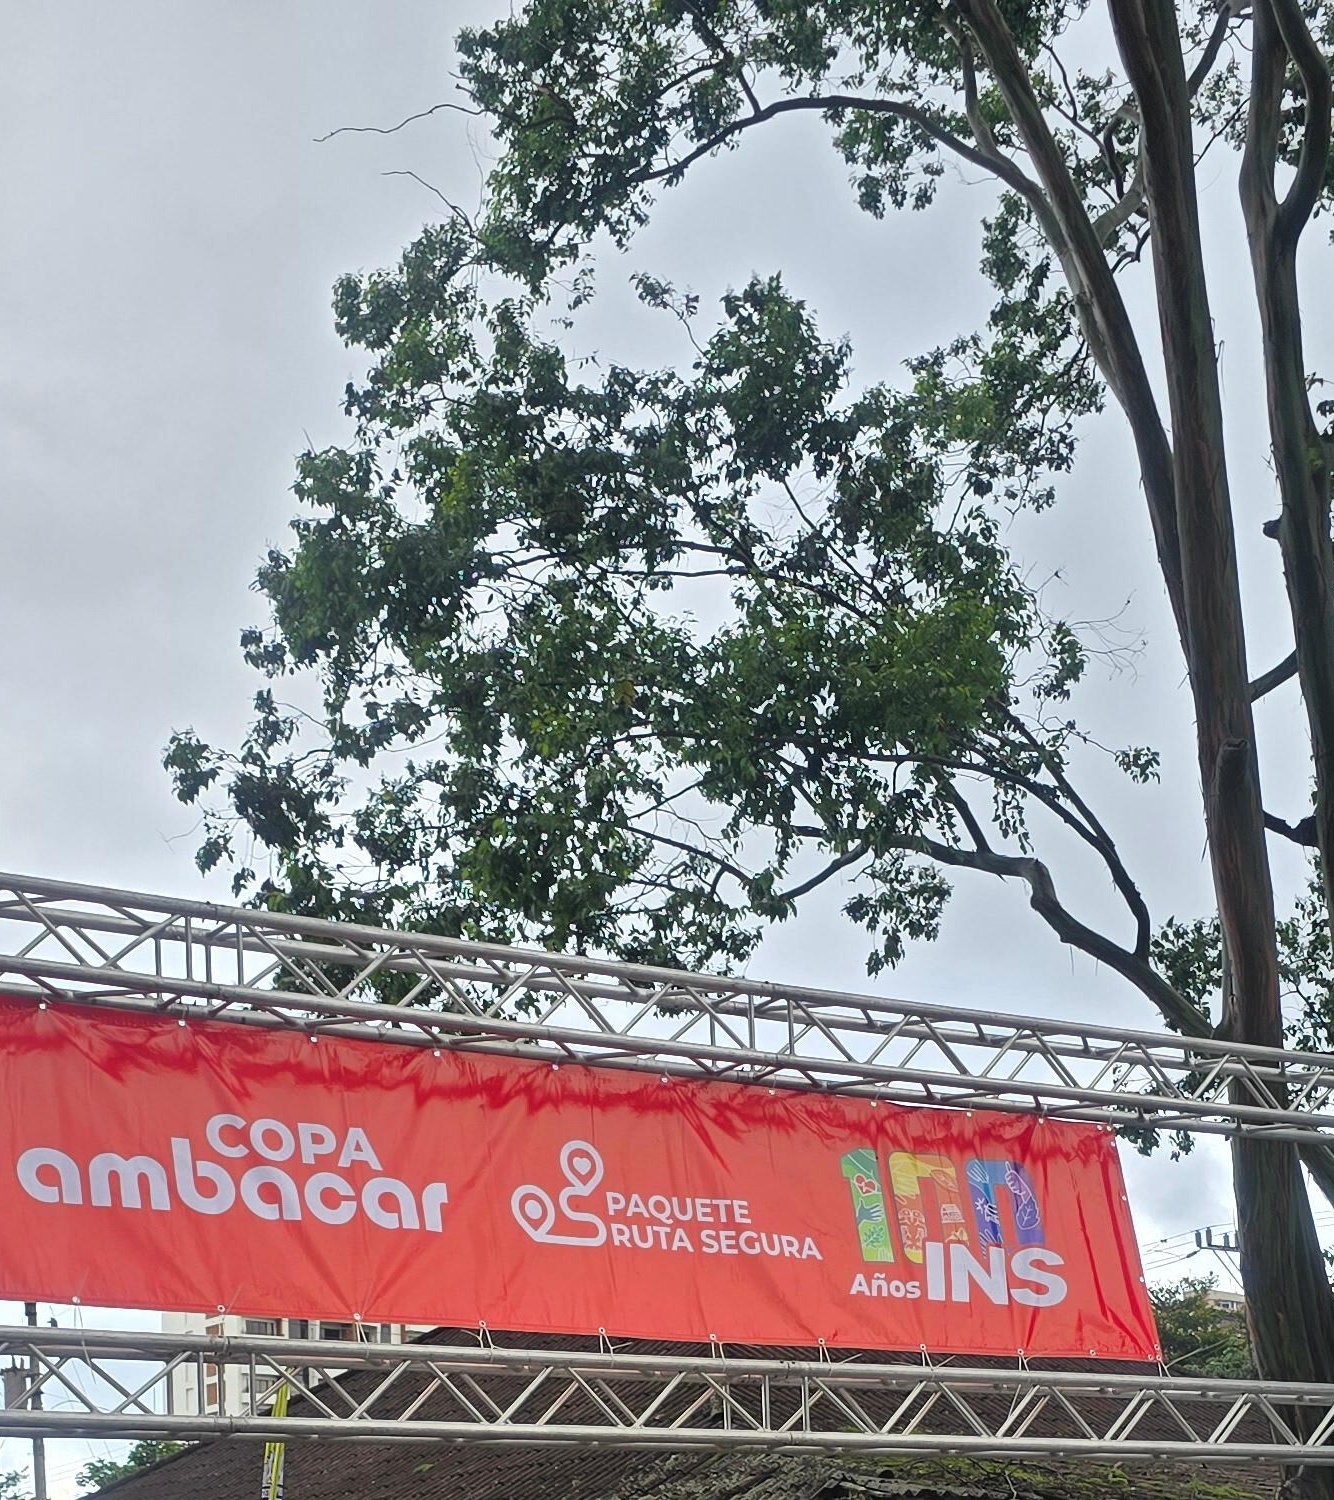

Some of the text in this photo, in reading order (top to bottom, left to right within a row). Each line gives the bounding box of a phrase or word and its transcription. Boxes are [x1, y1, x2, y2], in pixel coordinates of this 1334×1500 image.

[205, 1112, 383, 1172] COPA
[15, 1136, 449, 1234] ambacar
[606, 1190, 753, 1226] PAQUETE
[610, 1222, 824, 1262] RUTA SEGURA
[850, 1270, 922, 1301] Años
[924, 1238, 1069, 1309] INS
